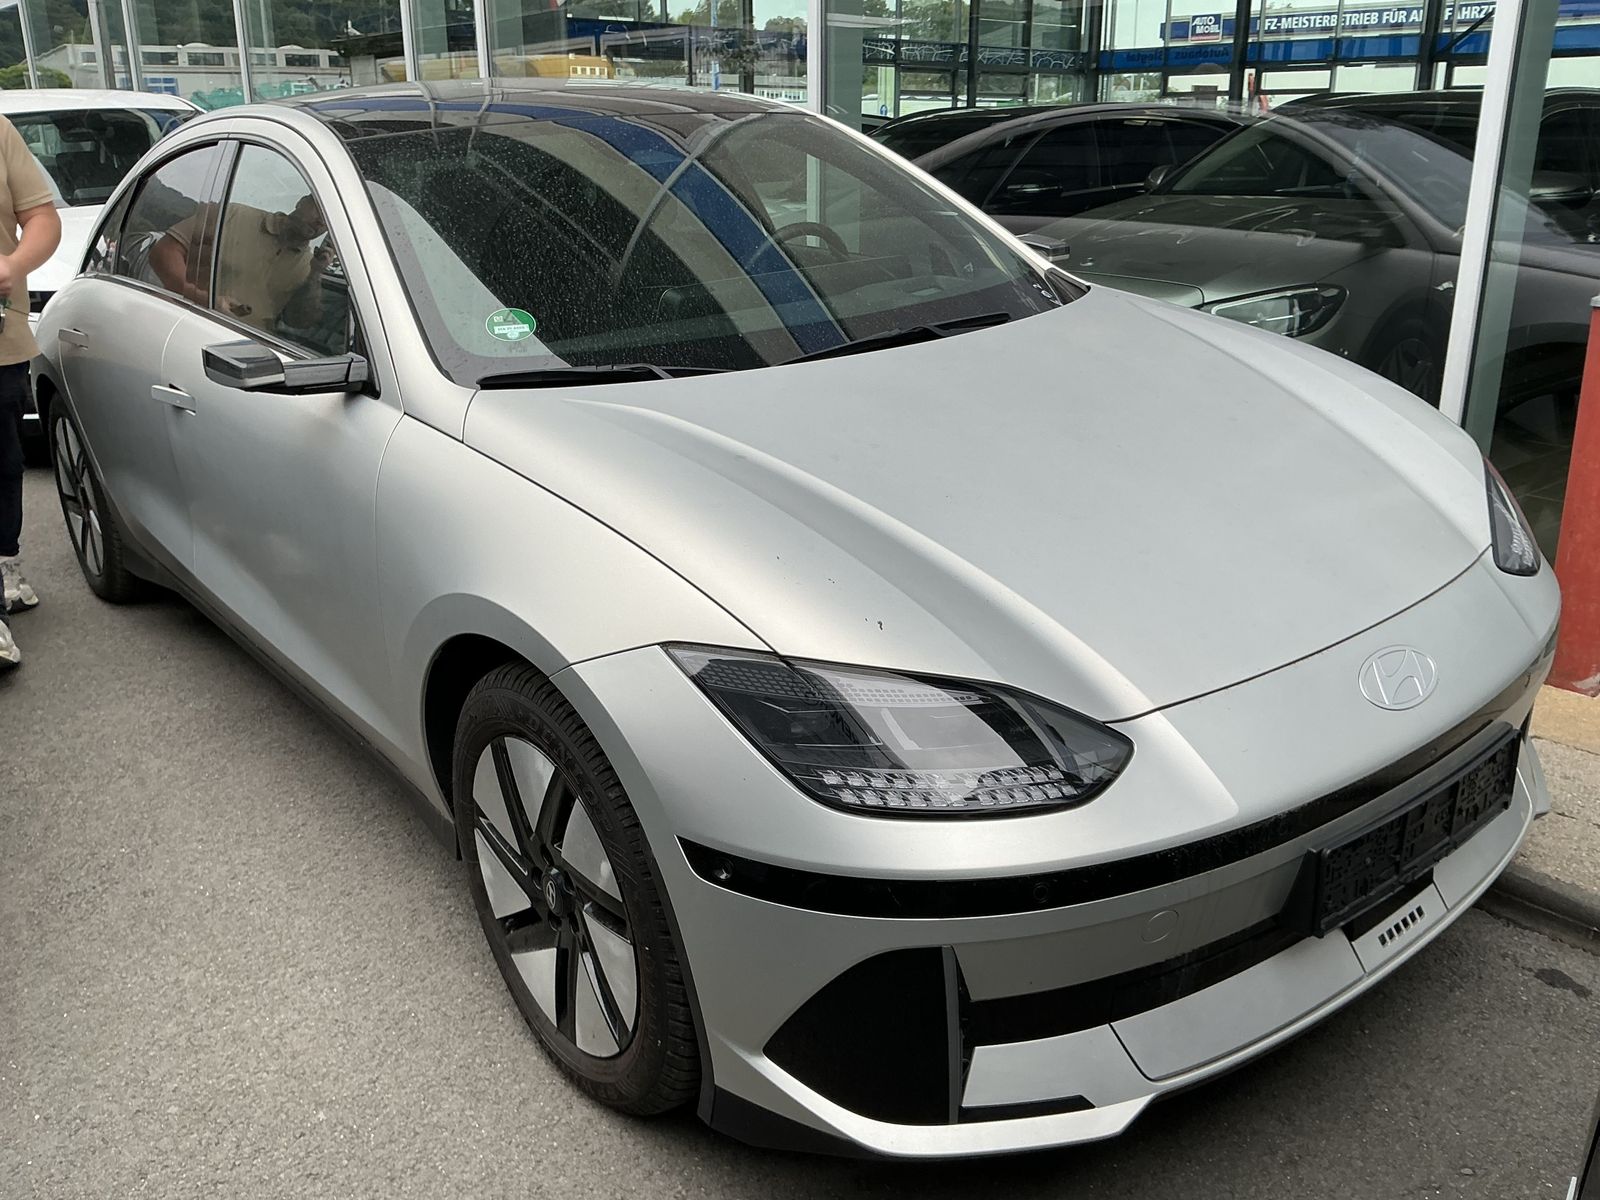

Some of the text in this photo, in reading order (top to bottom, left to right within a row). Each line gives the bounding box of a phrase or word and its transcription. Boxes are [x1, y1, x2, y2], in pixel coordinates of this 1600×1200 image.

[1192, 15, 1216, 26] AUTO
[1382, 8, 1408, 24] FÜR
[1196, 24, 1220, 34] MOBIL
